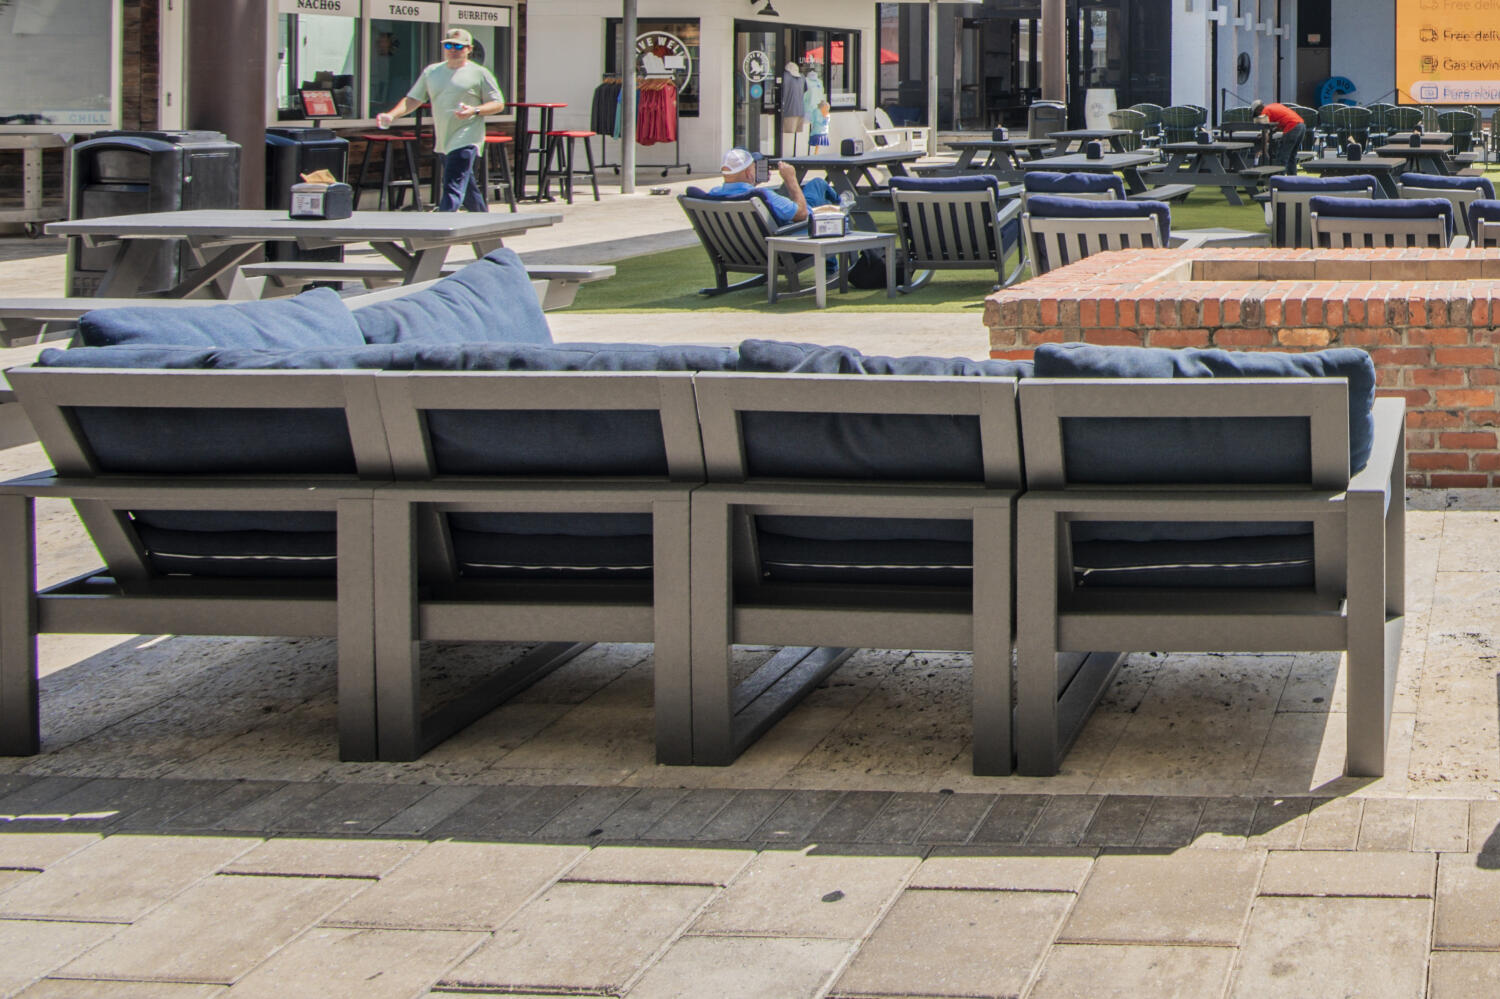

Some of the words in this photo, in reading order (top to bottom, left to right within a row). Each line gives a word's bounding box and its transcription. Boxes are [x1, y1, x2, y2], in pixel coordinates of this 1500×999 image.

[389, 4, 420, 16] TACOS
[457, 9, 499, 21] BURRITOS
[1443, 29, 1470, 41] Free
[1443, 58, 1466, 71] Gas
